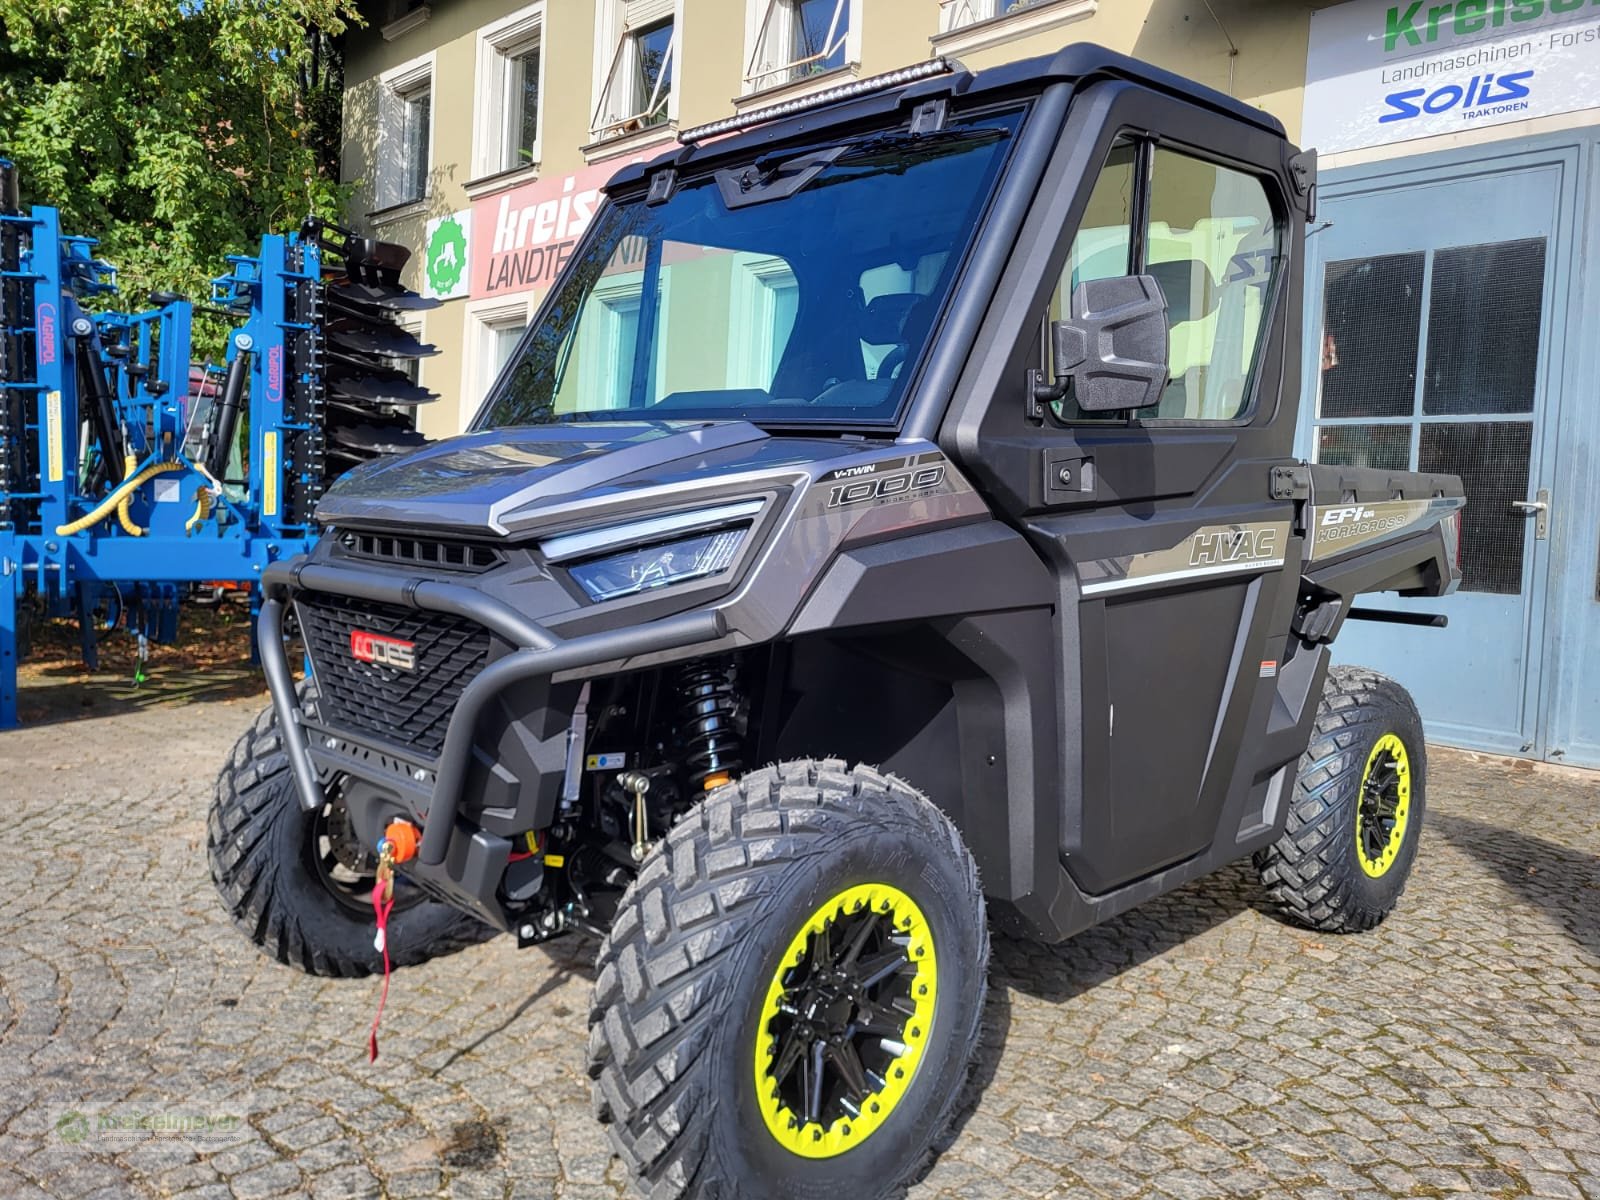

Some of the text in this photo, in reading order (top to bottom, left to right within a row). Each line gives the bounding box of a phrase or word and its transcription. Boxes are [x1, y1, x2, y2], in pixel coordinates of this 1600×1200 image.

[1384, 0, 1600, 52] Kreis
[1381, 41, 1532, 85] Landmaschinen
[1462, 101, 1529, 120] TRAKTOREN
[493, 176, 600, 254] kreis
[267, 345, 281, 391] AGRIPOL
[828, 465, 946, 508] 1000
[834, 464, 876, 479] V-TWIN
[1189, 528, 1277, 566] HVAC
[1316, 514, 1406, 544] WORKCROSS
